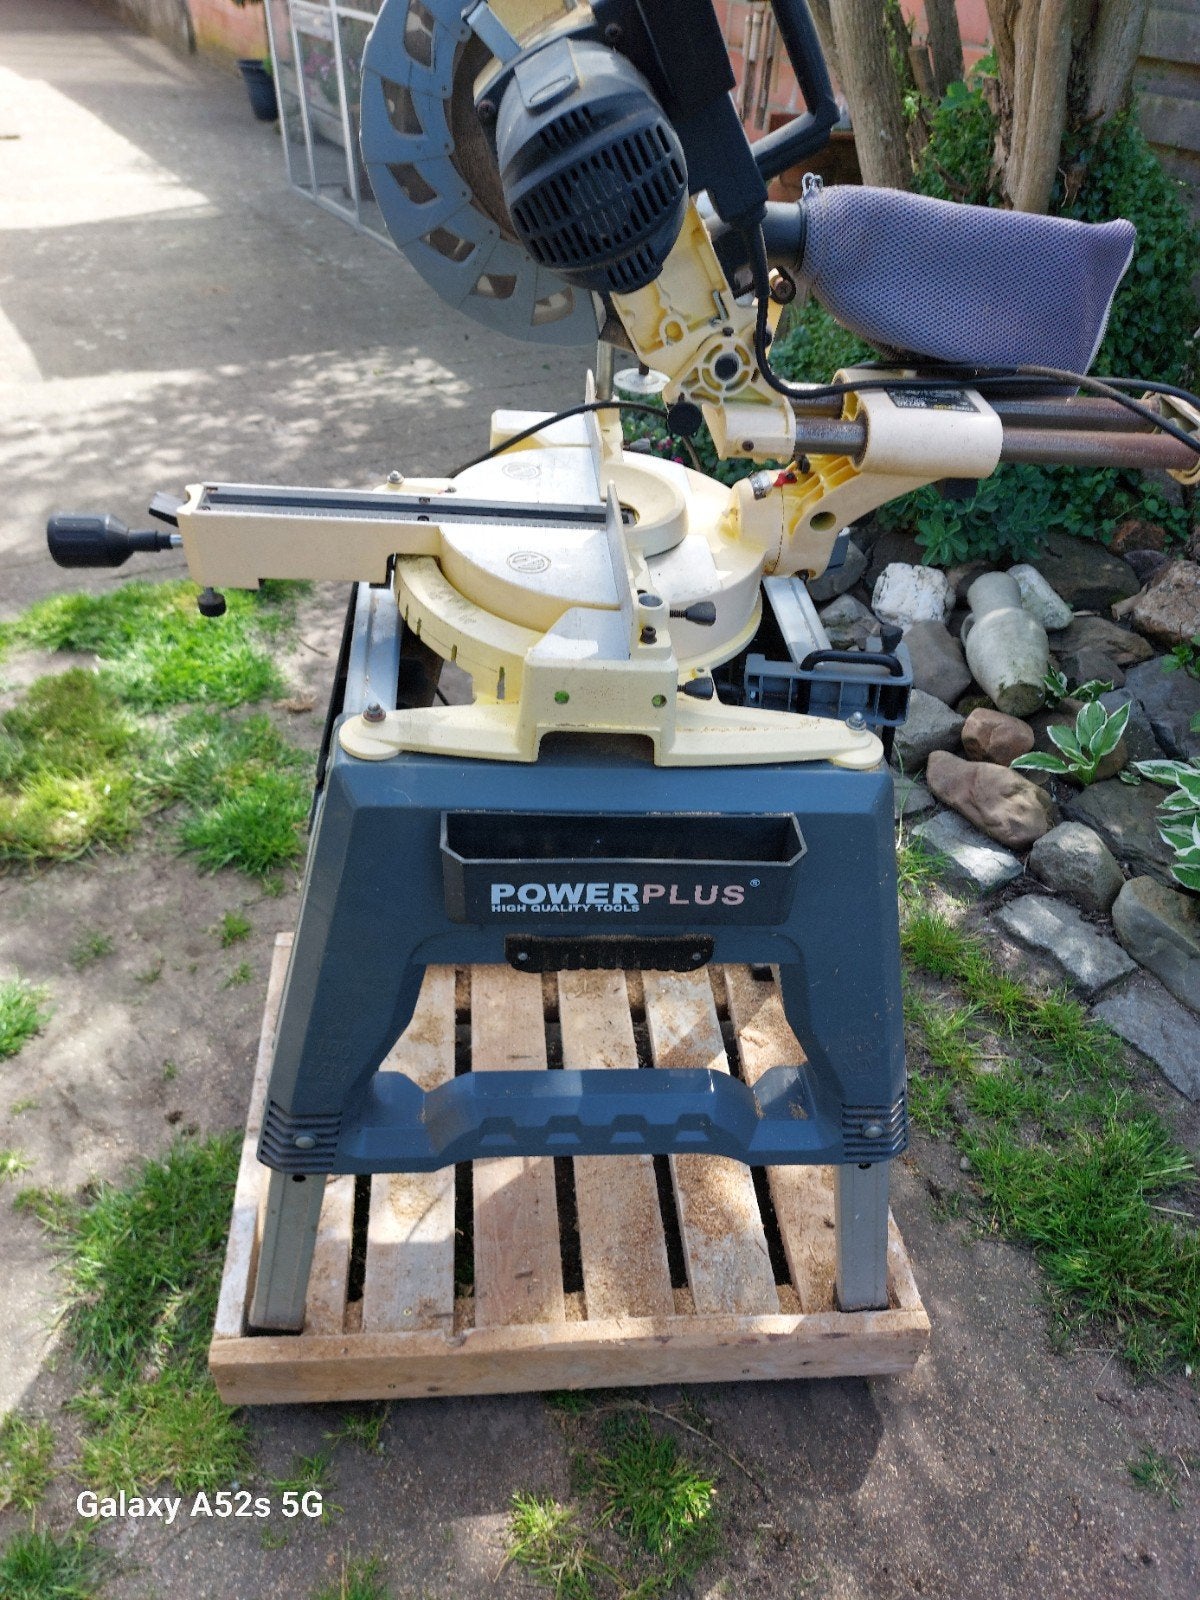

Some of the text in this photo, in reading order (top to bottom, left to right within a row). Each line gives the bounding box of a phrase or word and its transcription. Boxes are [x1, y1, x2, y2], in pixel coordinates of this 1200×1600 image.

[491, 904, 640, 913] HIGH QUALITY TOOLS
